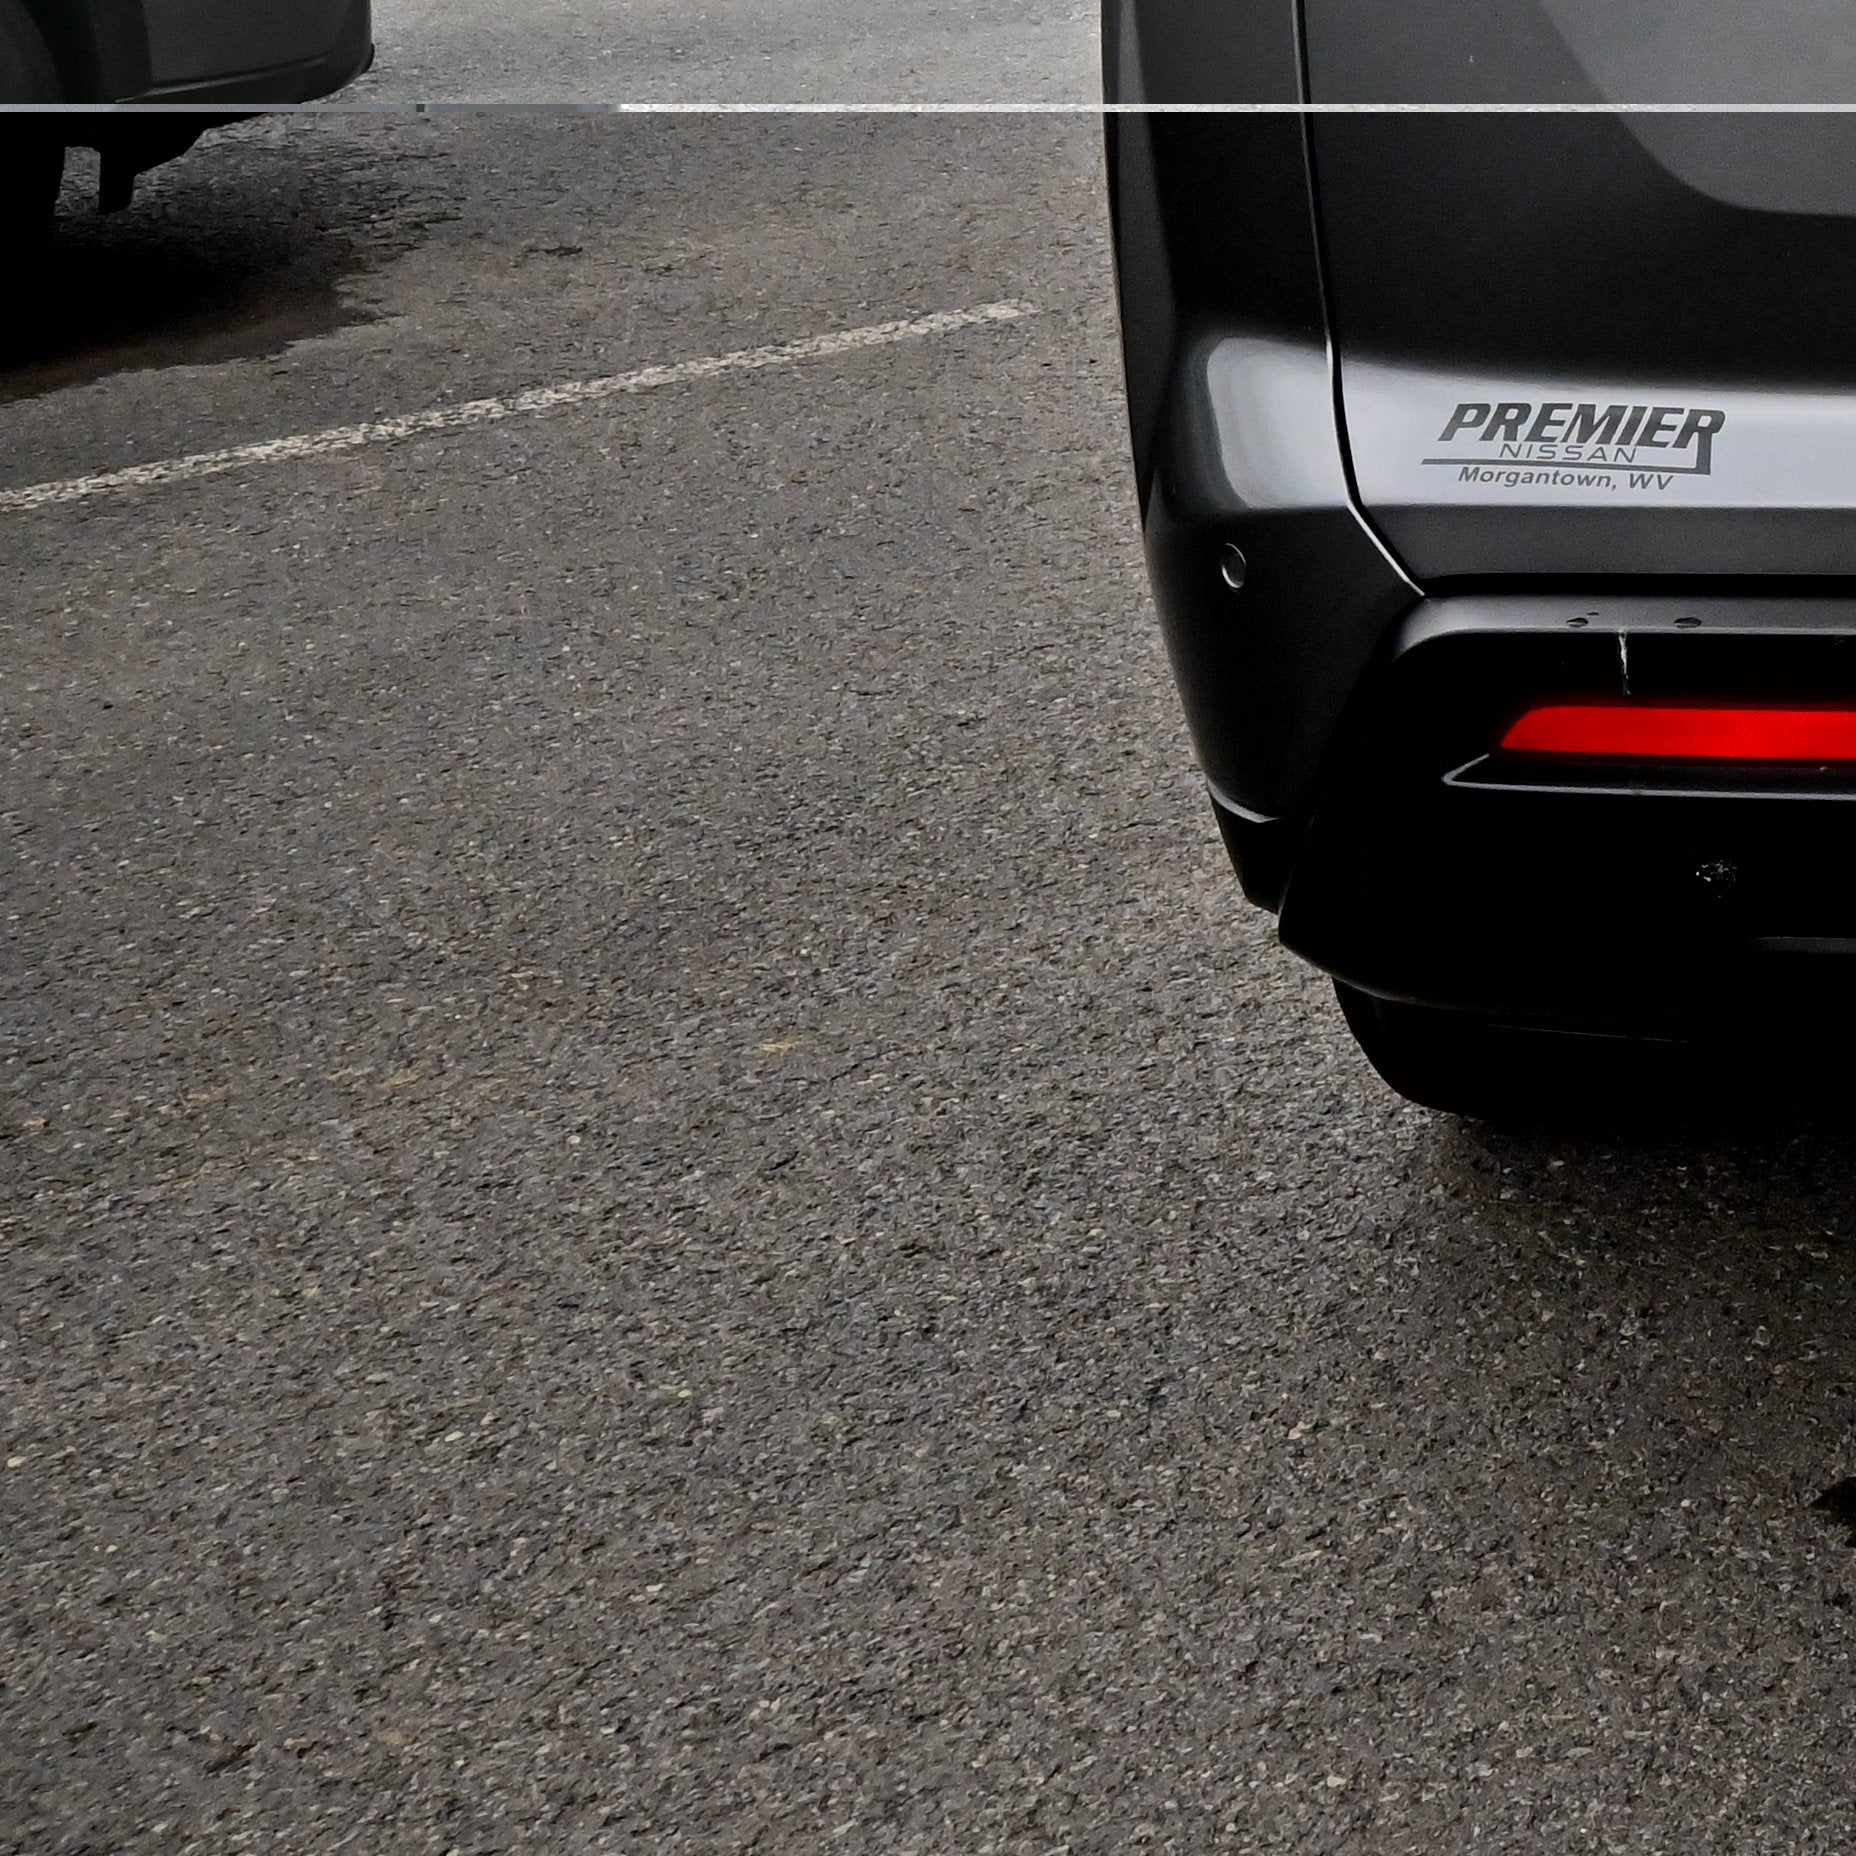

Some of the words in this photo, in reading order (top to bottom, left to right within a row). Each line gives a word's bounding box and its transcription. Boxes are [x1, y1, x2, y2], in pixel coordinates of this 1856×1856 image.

[1437, 401, 1728, 452] PREMIER
[1499, 443, 1638, 464] NISSAN
[1457, 466, 1618, 491] Morgantown,
[1628, 473, 1674, 491] WV
